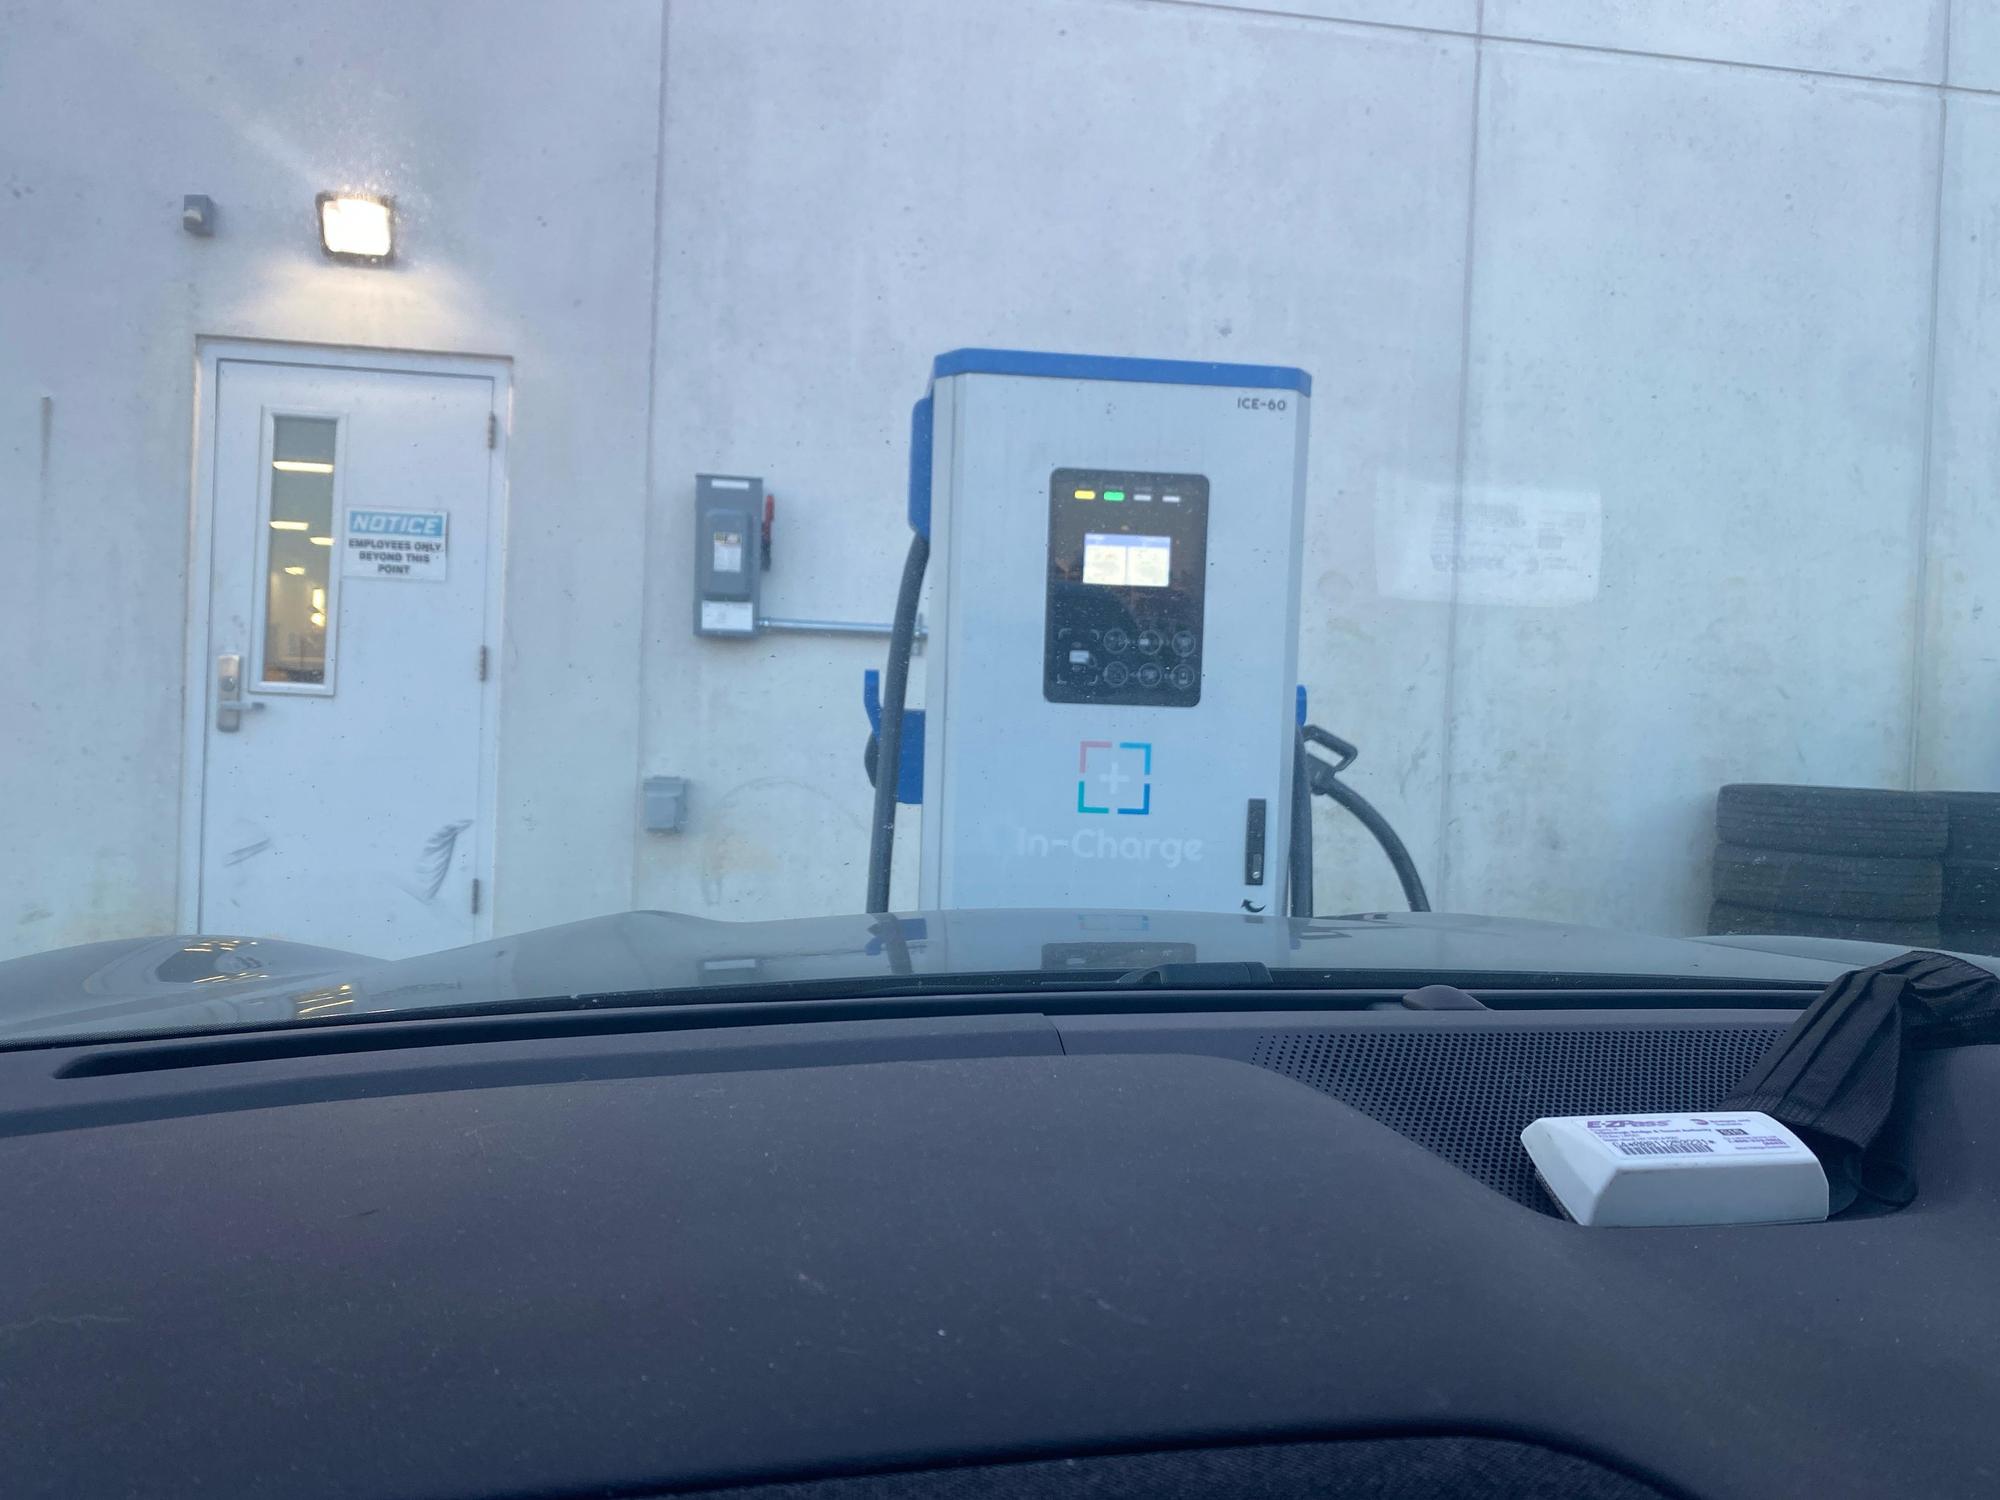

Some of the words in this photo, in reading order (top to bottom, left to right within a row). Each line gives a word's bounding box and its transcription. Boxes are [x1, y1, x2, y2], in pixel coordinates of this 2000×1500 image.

[1237, 398, 1286, 411] ICE-60
[352, 513, 440, 534] NOTICE
[348, 538, 411, 550] EMPLOYEES
[414, 541, 442, 552] ONLY
[359, 551, 402, 561] BEYOND
[406, 553, 430, 563] THIS
[378, 563, 411, 574] POINT
[1015, 826, 1203, 868] In-Charge
